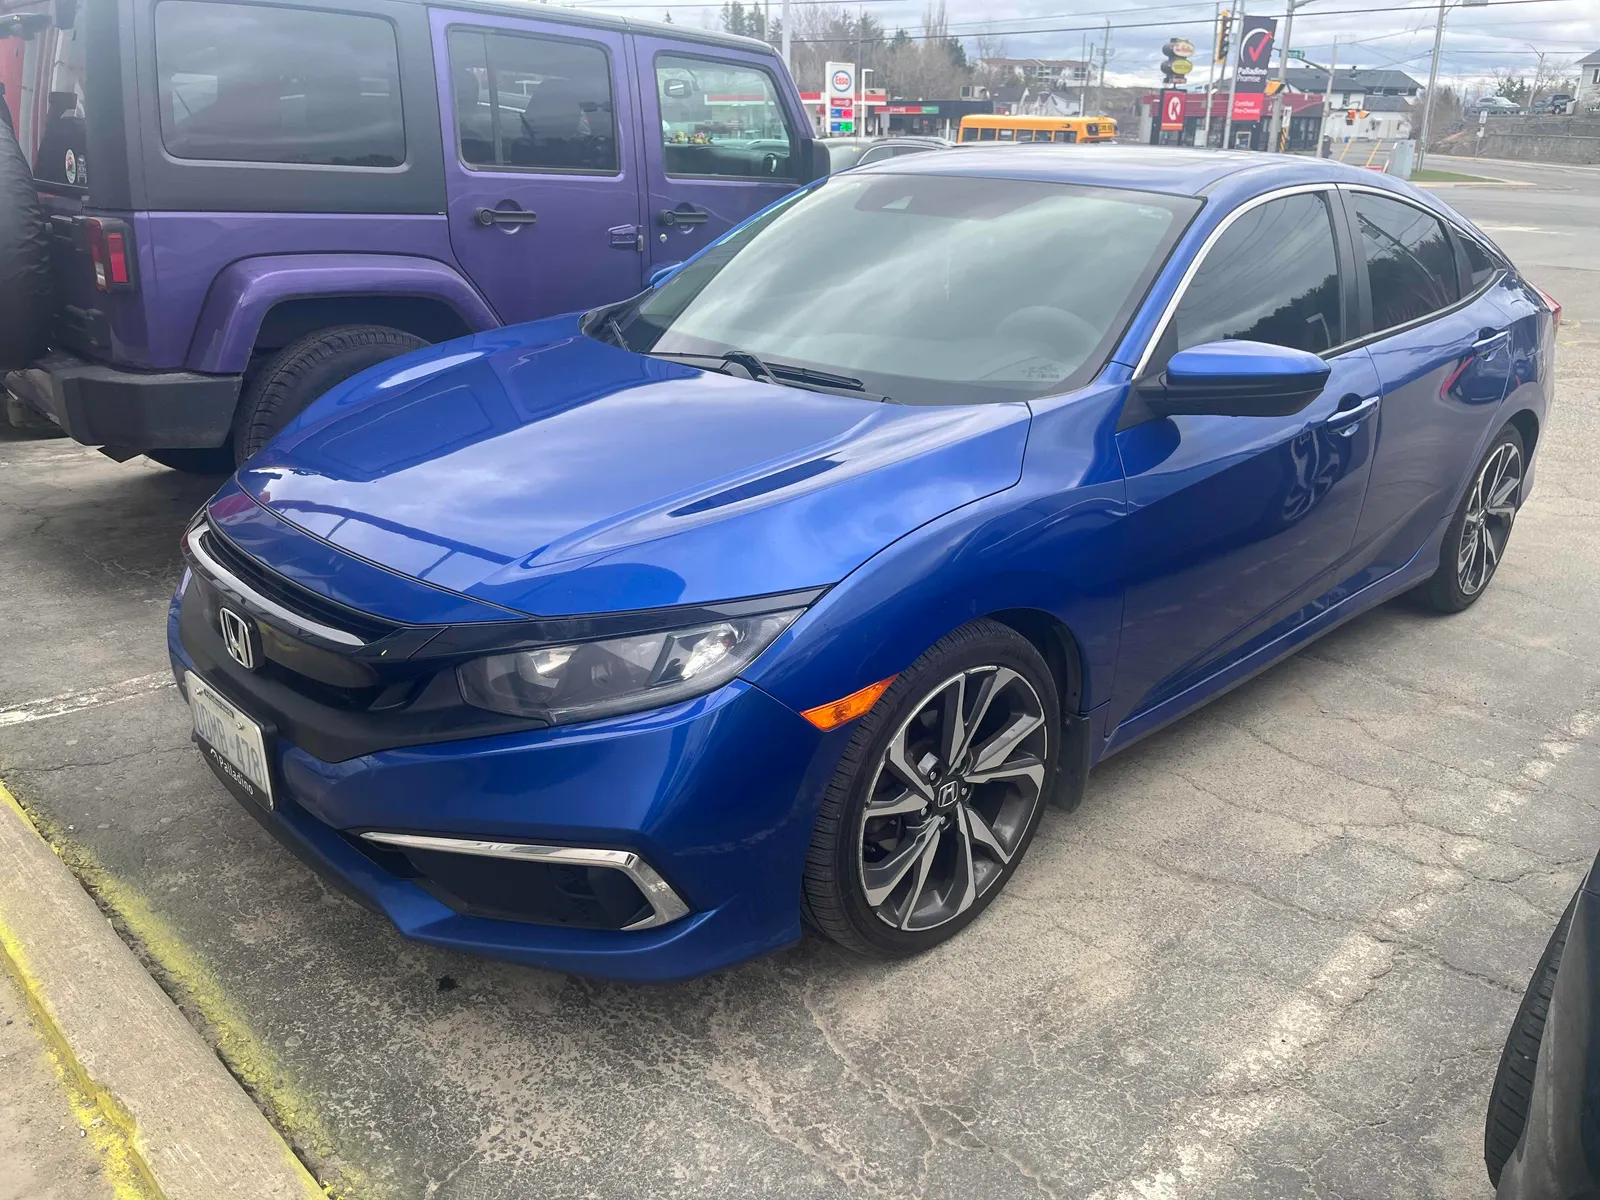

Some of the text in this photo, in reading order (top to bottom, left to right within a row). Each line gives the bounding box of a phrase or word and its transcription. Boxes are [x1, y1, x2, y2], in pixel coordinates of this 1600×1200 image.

[1237, 67, 1268, 76] Palladino
[835, 75, 849, 85] Esso
[217, 756, 254, 796] Palladino
